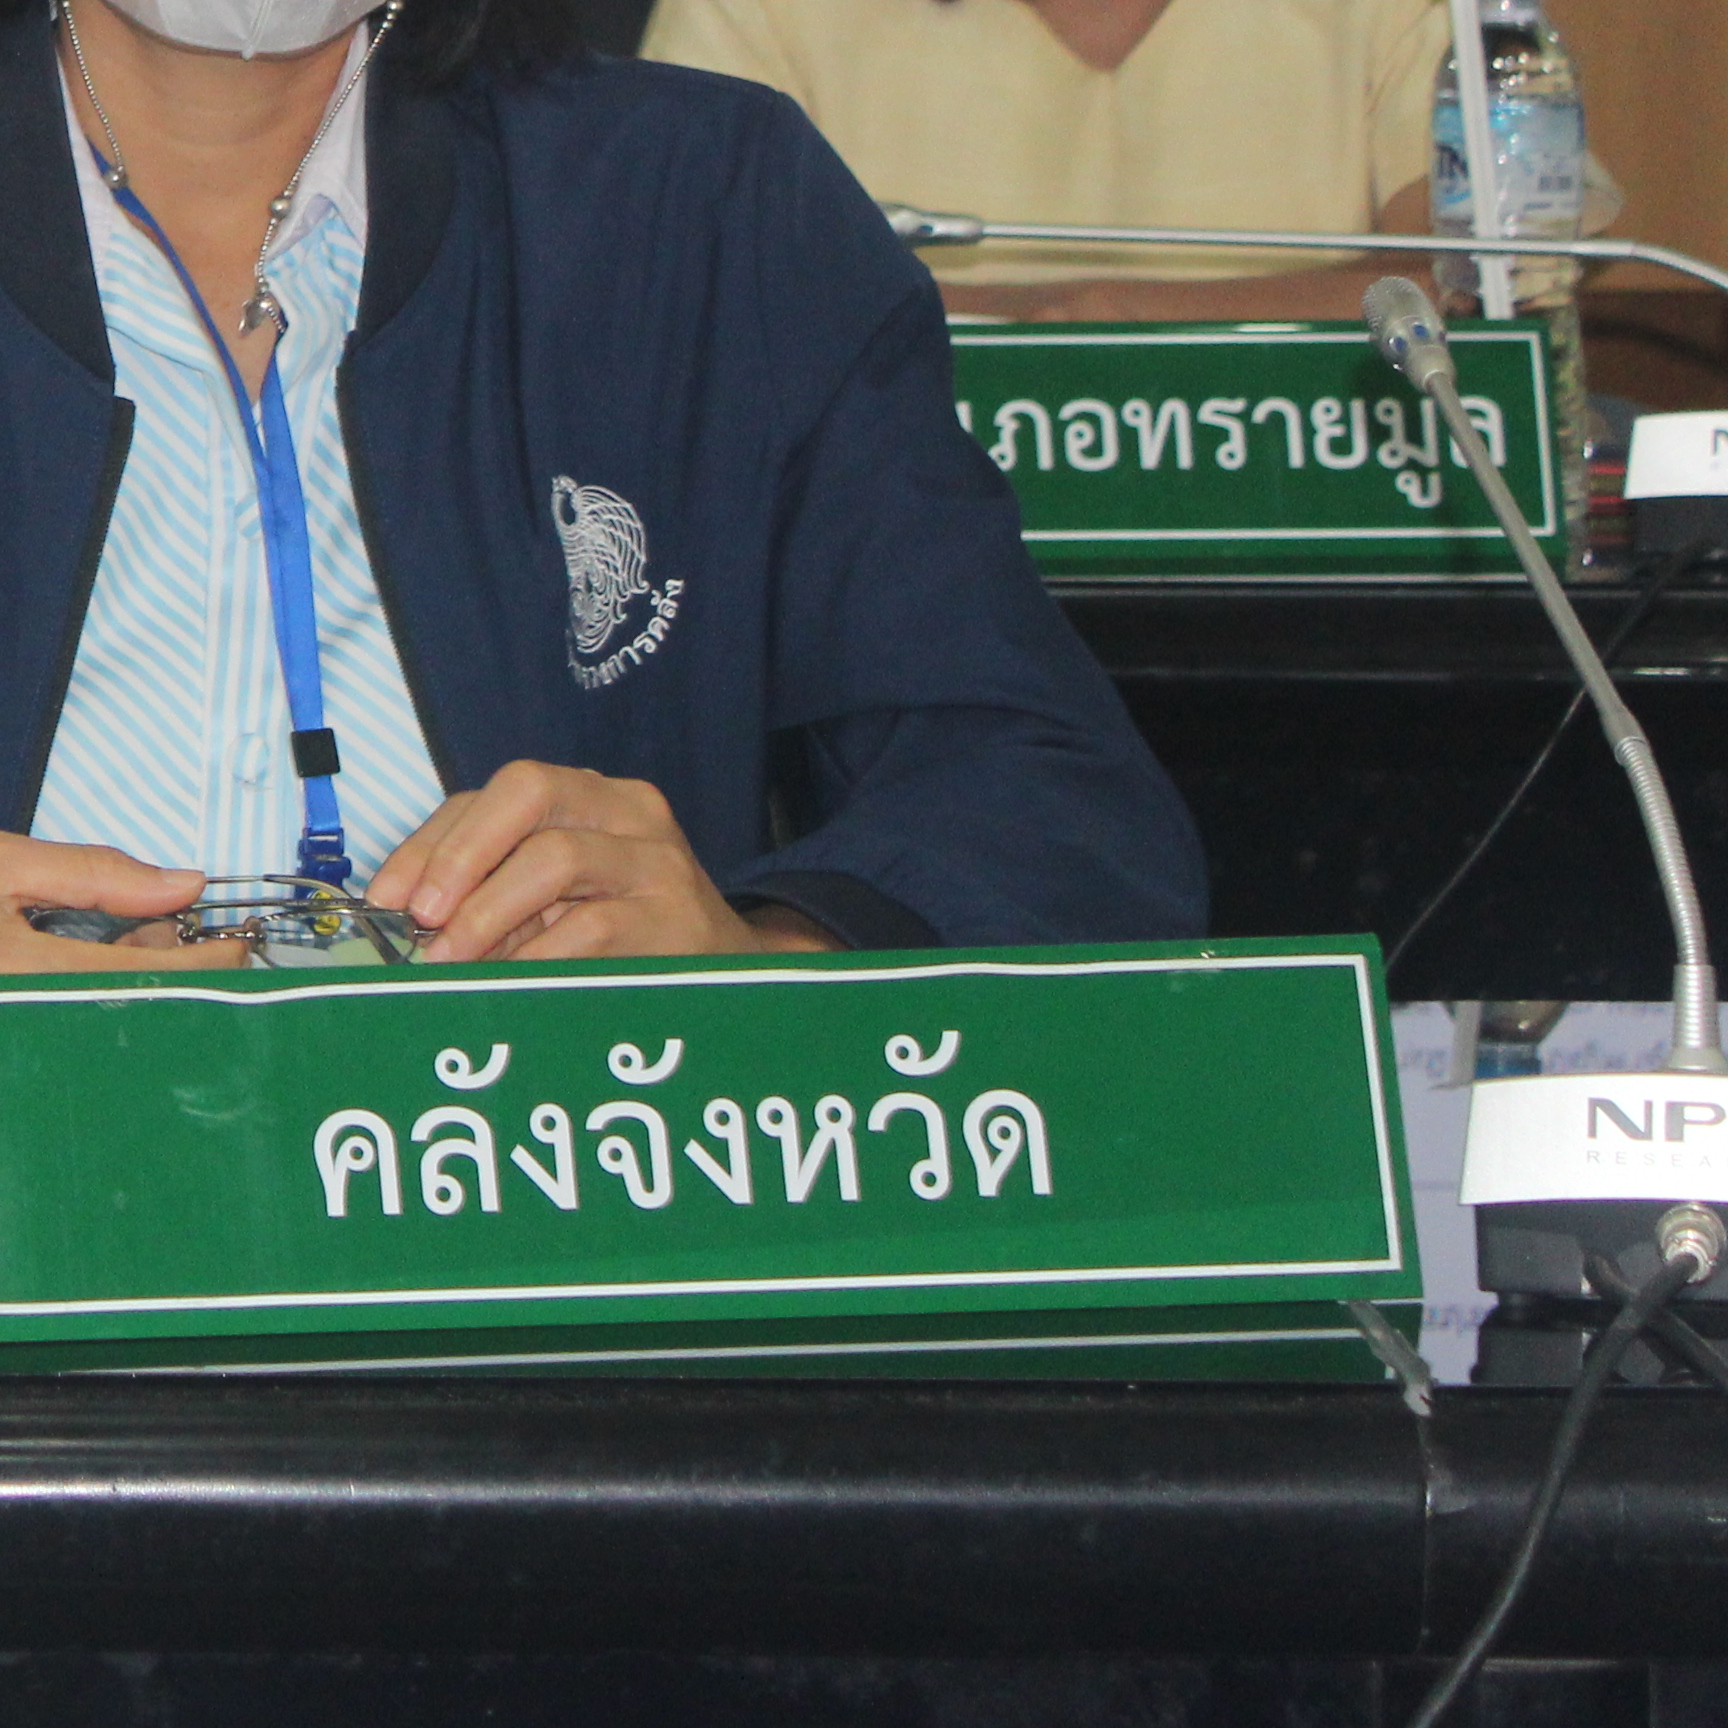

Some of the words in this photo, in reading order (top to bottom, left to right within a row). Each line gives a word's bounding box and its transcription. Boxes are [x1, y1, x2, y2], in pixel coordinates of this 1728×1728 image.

[956, 396, 1507, 509] ภอทรายมูล
[314, 1029, 1054, 1217] คลังจังหวัด
[1586, 1149, 1728, 1169] RESEA
[1587, 1096, 1728, 1144] NP
